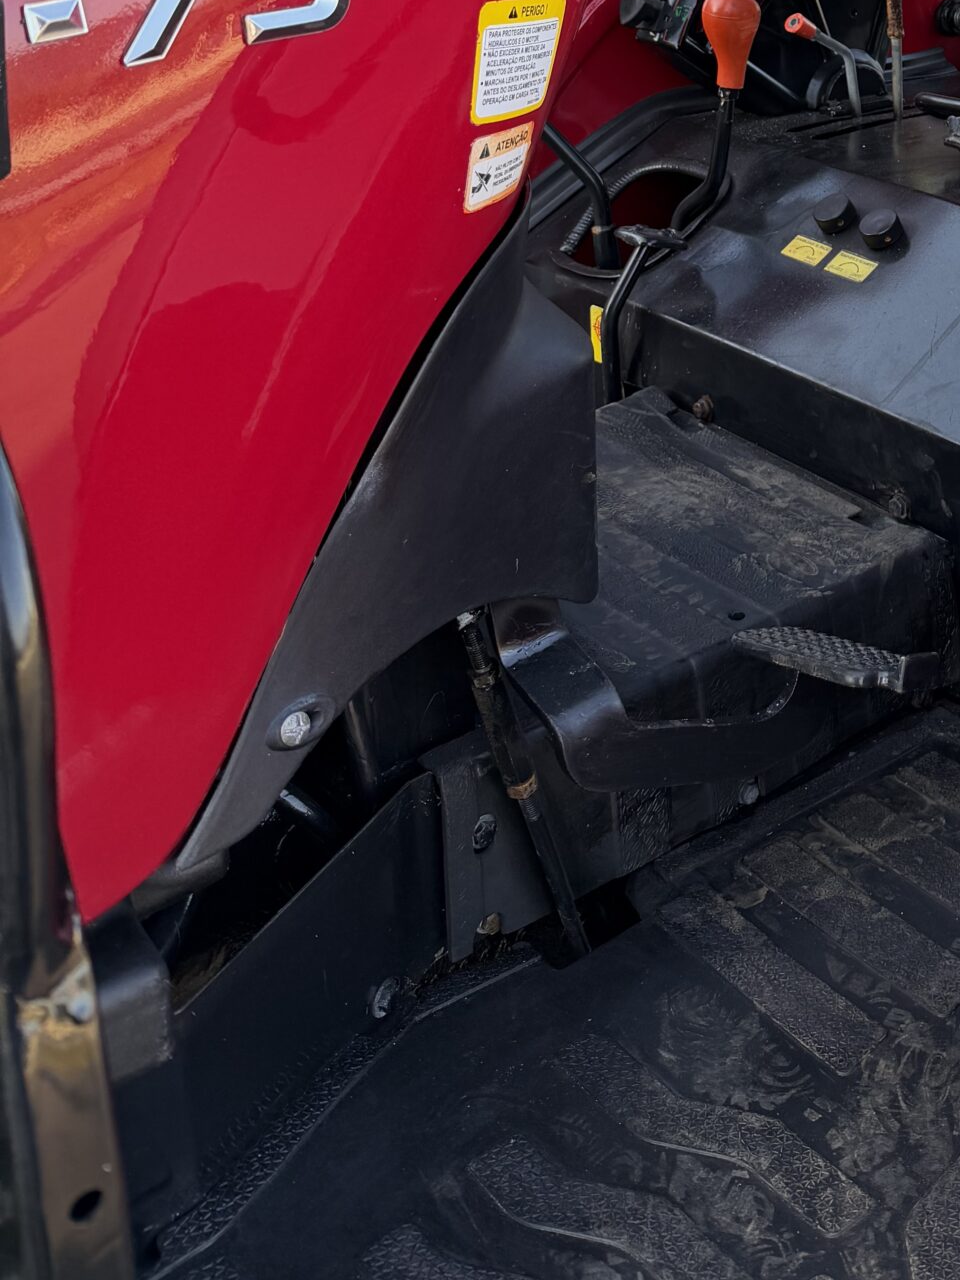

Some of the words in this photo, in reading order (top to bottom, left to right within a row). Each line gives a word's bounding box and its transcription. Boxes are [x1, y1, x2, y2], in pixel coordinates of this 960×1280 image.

[521, 4, 545, 17] PERIGO
[489, 30, 502, 38] PARA
[502, 27, 525, 37] PROTEGER
[496, 131, 528, 152] ATENÇÃO
